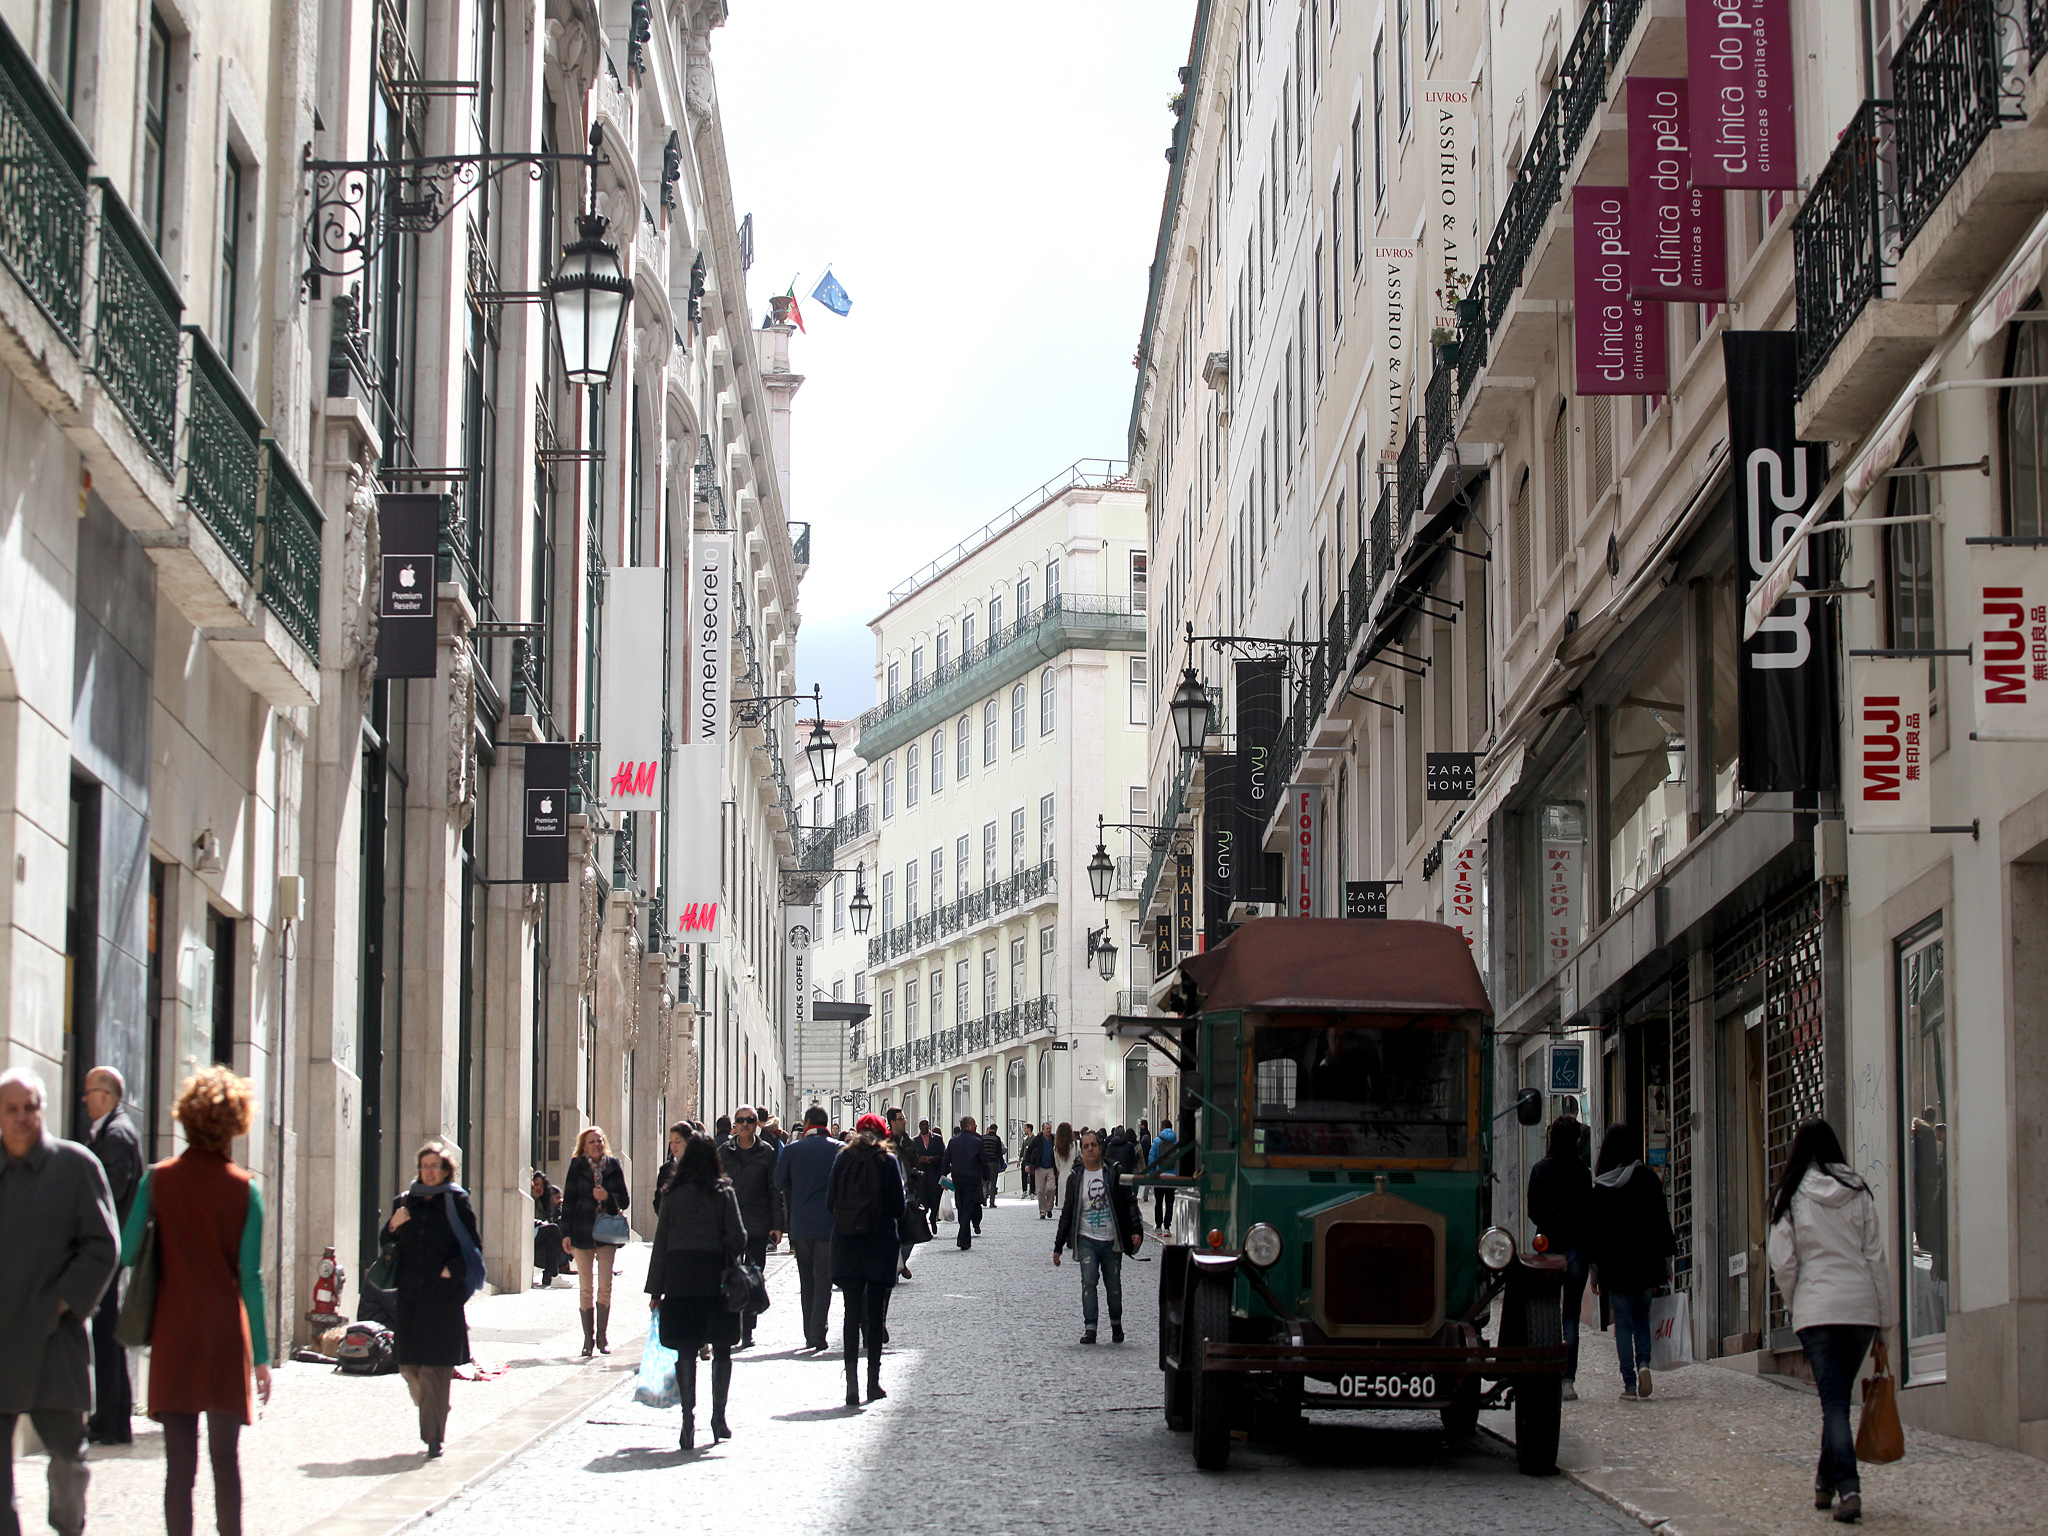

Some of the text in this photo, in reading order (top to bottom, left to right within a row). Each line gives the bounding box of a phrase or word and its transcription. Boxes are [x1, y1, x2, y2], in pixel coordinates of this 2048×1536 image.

[1710, 37, 1743, 70] do
[1425, 91, 1468, 103] LIVROS
[1713, 86, 1748, 173] clínica
[1758, 108, 1770, 172] clinicas
[1439, 108, 1457, 206] ASSÍRIO
[1648, 91, 1688, 287] clínica do pêlo
[1442, 214, 1456, 231] &
[1375, 248, 1414, 258] LIVROS
[1691, 225, 1703, 286] clinicas
[1593, 199, 1631, 382] clínica do pêlo
[1387, 262, 1404, 446] ASSÍRIO & ALVIM
[1633, 325, 1644, 380] clinicas
[391, 591, 423, 601] Premium
[393, 601, 421, 610] Reseller
[701, 566, 719, 738] women'secret
[1982, 586, 2027, 704] MUJI
[2030, 605, 2048, 681] 無印良品
[1427, 765, 1474, 776] ZARA
[1863, 696, 1901, 801] MUJI
[1905, 713, 1921, 781] 無印良品
[611, 760, 658, 798] H&M
[1251, 746, 1268, 800] envy
[1427, 780, 1475, 791] HOME
[534, 817, 558, 825] Premium
[535, 824, 557, 832] Reseller
[1217, 830, 1234, 878] envy
[1180, 865, 1193, 930] HAIR
[1347, 891, 1386, 901] ZARA
[1452, 849, 1476, 916] MAISON
[679, 901, 718, 933] H&M
[1347, 904, 1386, 913] HOME
[795, 955, 803, 991] COFFEE
[1340, 1375, 1436, 1398] OE-50-80
